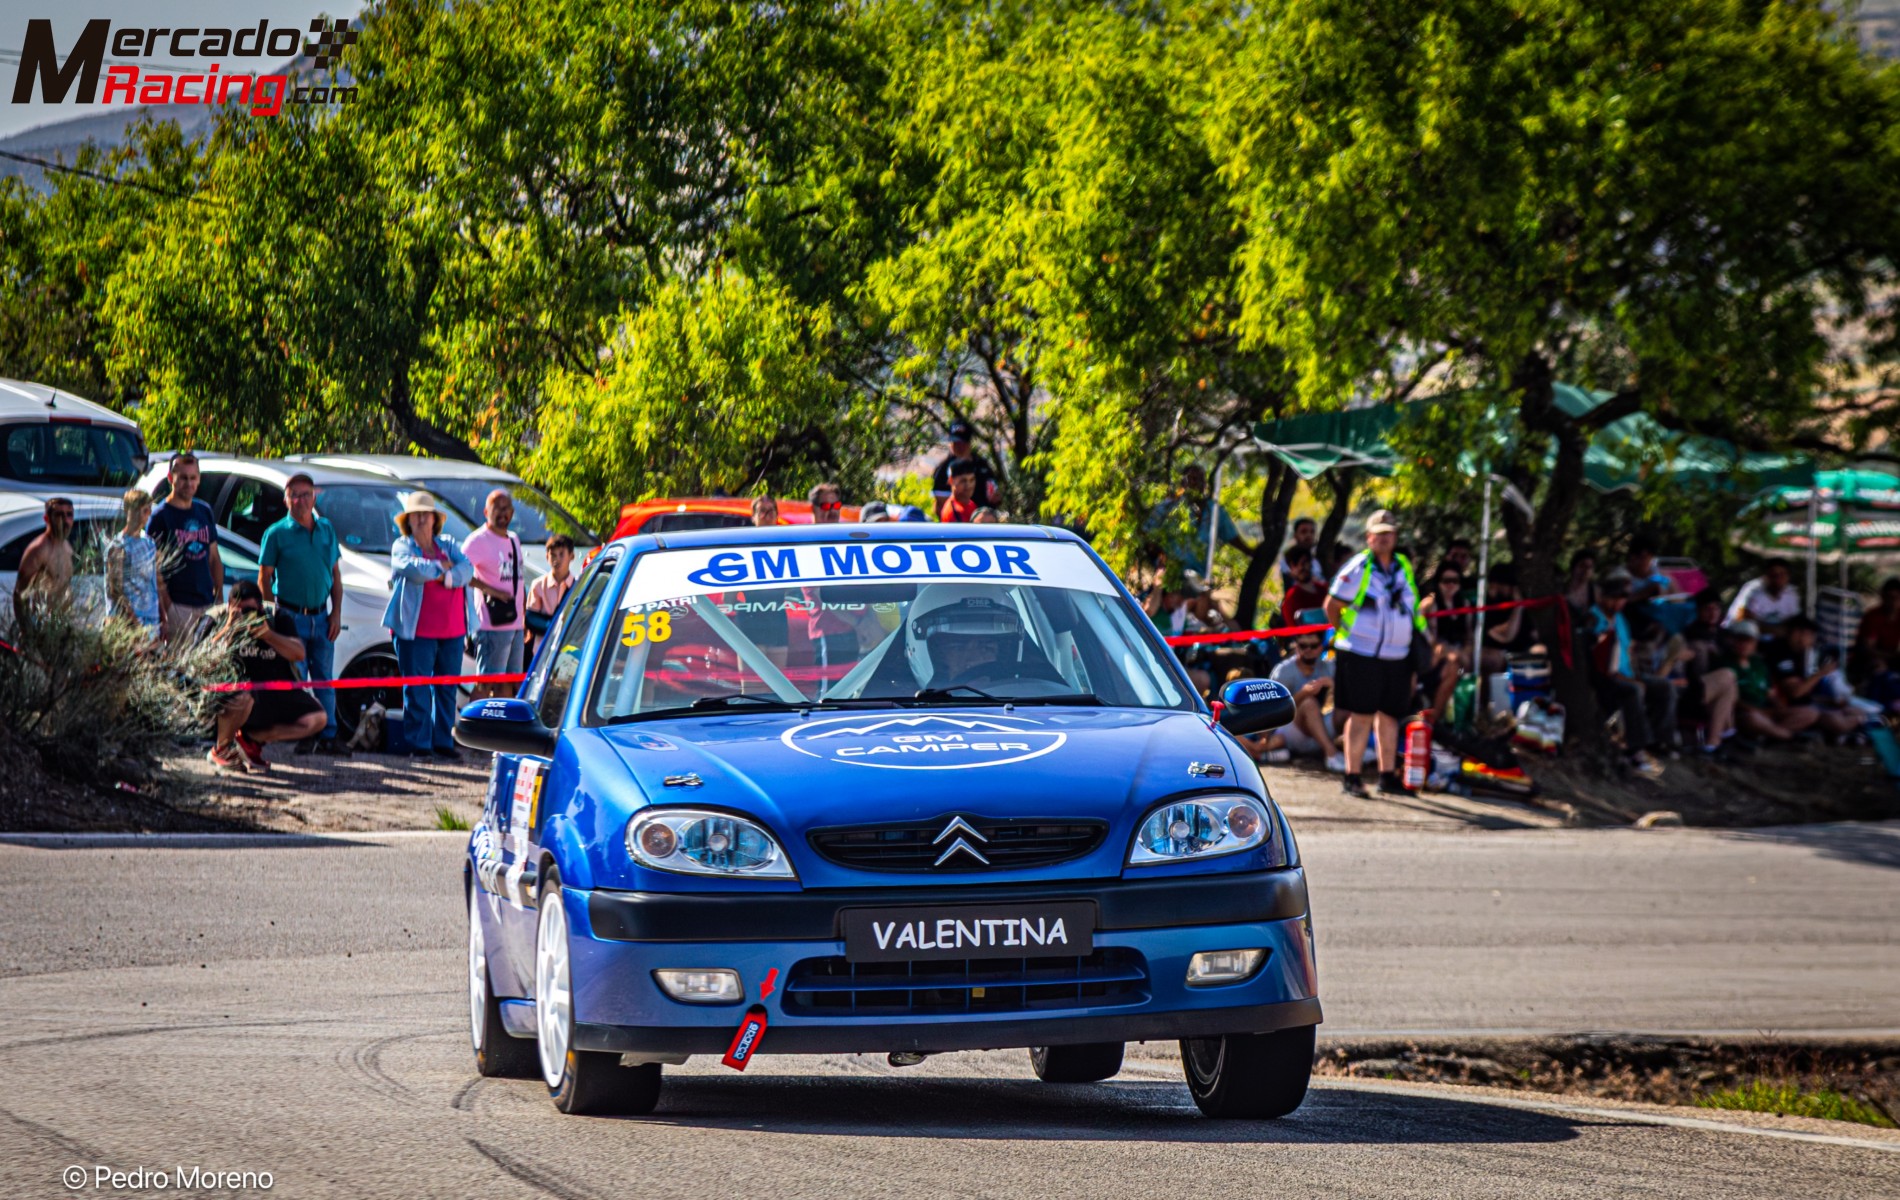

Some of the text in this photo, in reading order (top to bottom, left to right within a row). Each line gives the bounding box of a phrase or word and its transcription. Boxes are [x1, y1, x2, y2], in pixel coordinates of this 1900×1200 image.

[700, 544, 1040, 584] GM MOTOR
[645, 595, 698, 611] PATRI
[621, 610, 672, 647] 58
[1245, 682, 1277, 692] AINHOA
[1249, 691, 1280, 702] MIGUEL
[481, 709, 507, 718] PAUL
[892, 734, 964, 743] GM
[836, 742, 1031, 757] CAMPER
[873, 917, 1068, 949] VALENTINA
